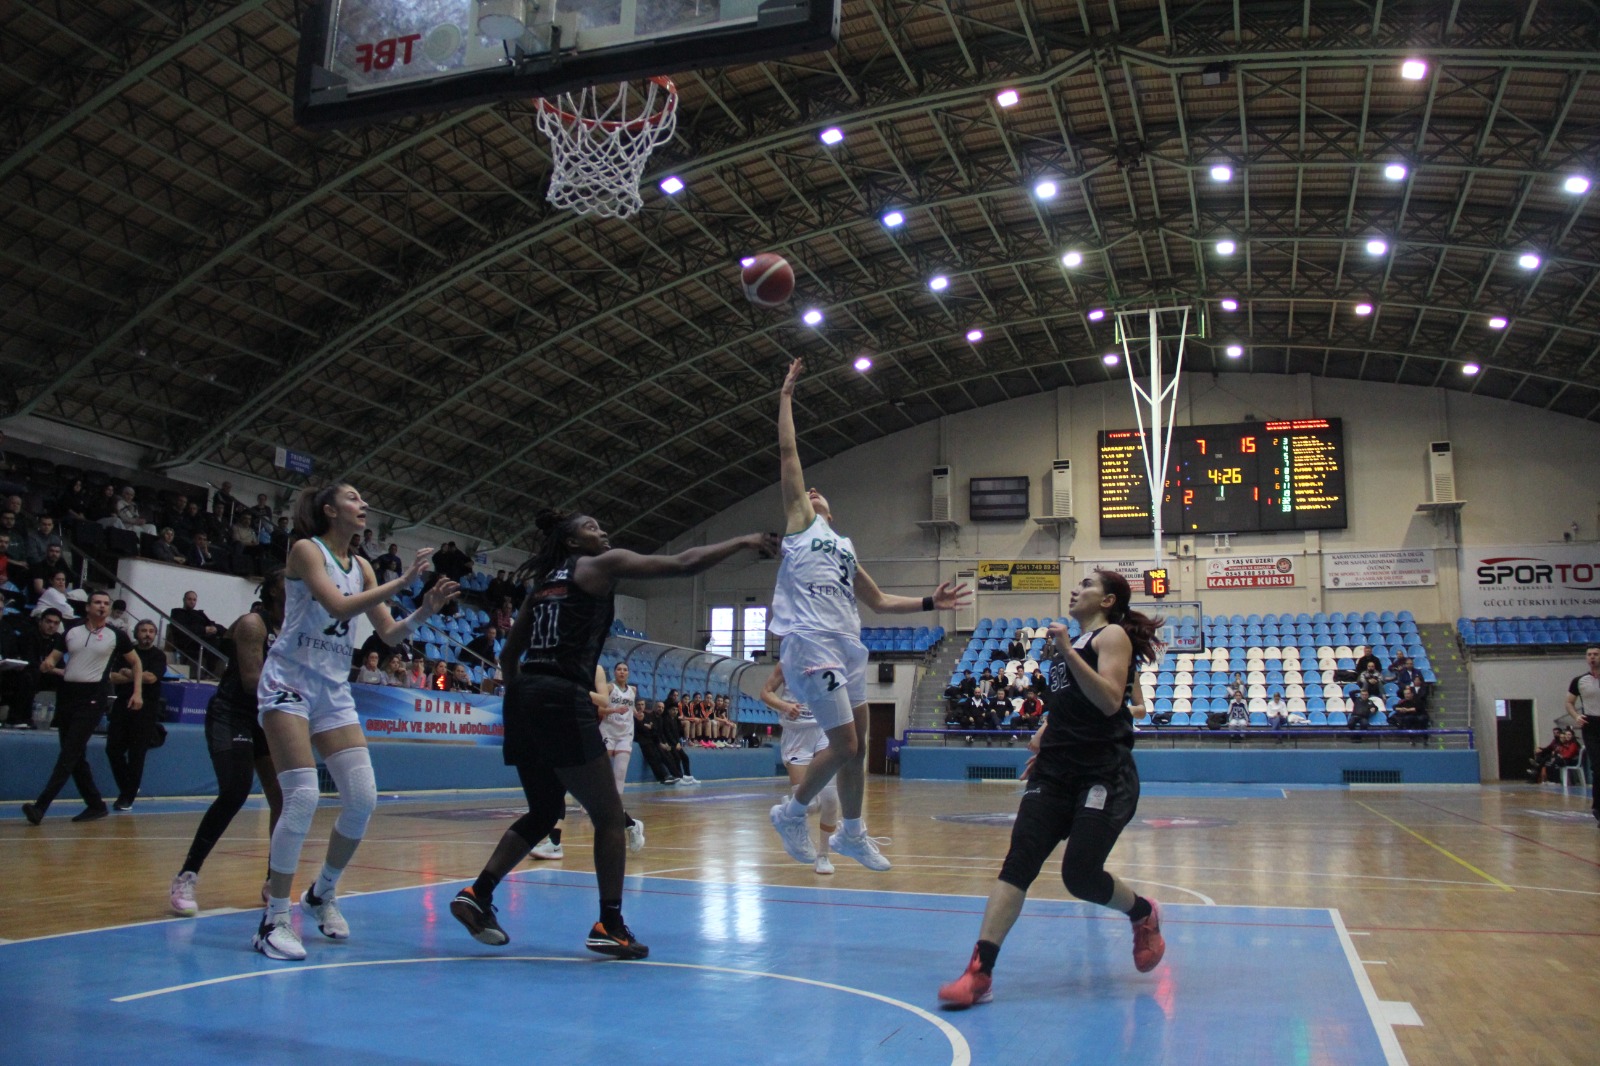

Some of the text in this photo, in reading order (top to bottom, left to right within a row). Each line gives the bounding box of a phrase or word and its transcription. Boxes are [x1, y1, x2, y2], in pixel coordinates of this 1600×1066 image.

[1196, 439, 1206, 455] 7
[1241, 437, 1256, 453] 15
[1208, 468, 1242, 484] 4:26
[1184, 490, 1194, 504] 2
[839, 565, 850, 586] 2
[1209, 576, 1292, 587] KARATE KURSU
[1152, 579, 1165, 594] 16
[1484, 598, 1514, 607] GÜÇLÜ
[1517, 597, 1557, 606] TÜRKİYE
[530, 601, 560, 649] 11
[822, 670, 840, 692] 2
[1050, 661, 1071, 693] 32
[414, 698, 471, 715] EDİRNE
[366, 718, 408, 735] GENÇLİK
[410, 720, 422, 733] VE
[424, 721, 447, 734] SPOR
[449, 720, 457, 734] İL
